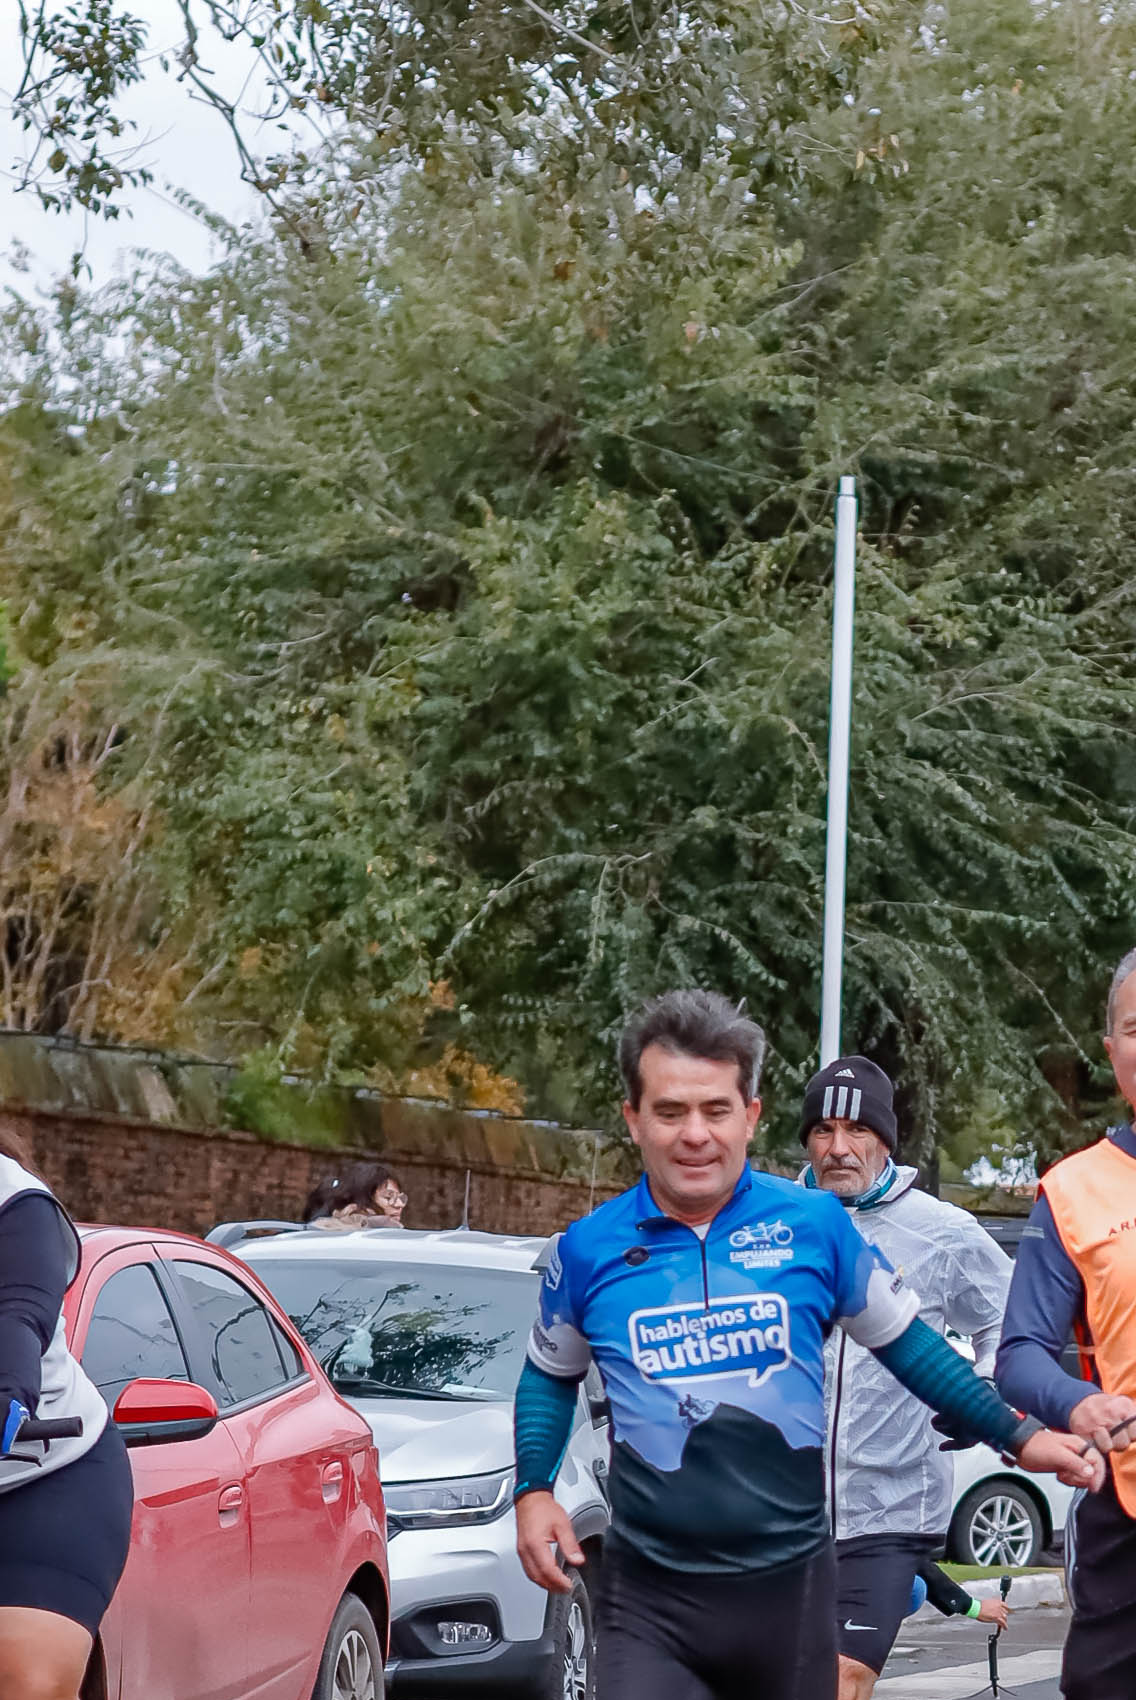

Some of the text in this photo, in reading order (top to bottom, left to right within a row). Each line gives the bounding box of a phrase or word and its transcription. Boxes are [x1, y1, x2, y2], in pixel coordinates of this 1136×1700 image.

[638, 1299, 777, 1344] hablemos de
[638, 1324, 785, 1373] autismo
